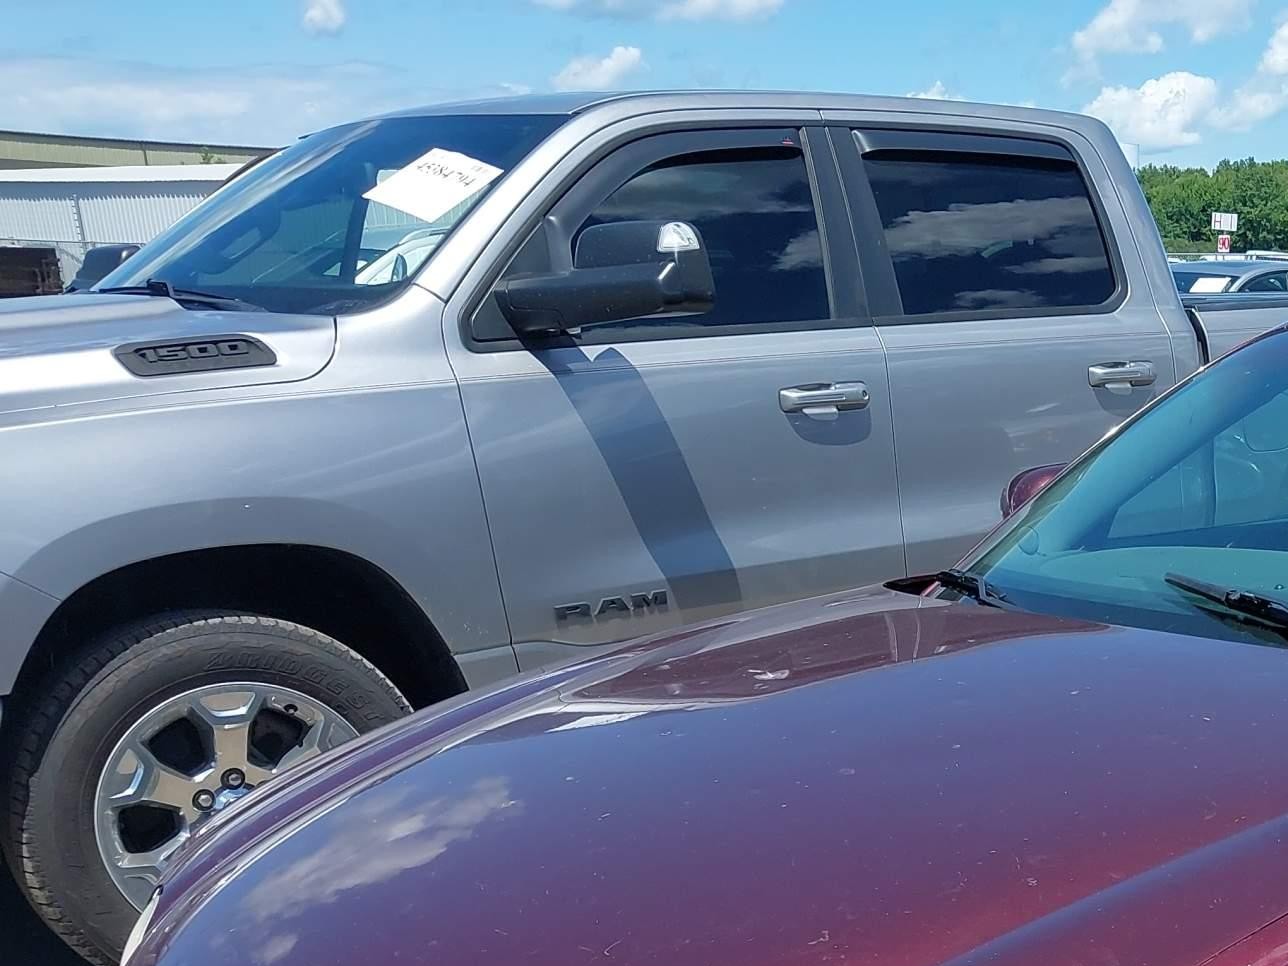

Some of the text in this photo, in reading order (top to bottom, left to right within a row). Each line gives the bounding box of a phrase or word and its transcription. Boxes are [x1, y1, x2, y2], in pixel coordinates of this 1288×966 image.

[1218, 237, 1230, 250] 90
[136, 340, 250, 363] 1500
[553, 588, 668, 620] RAM
